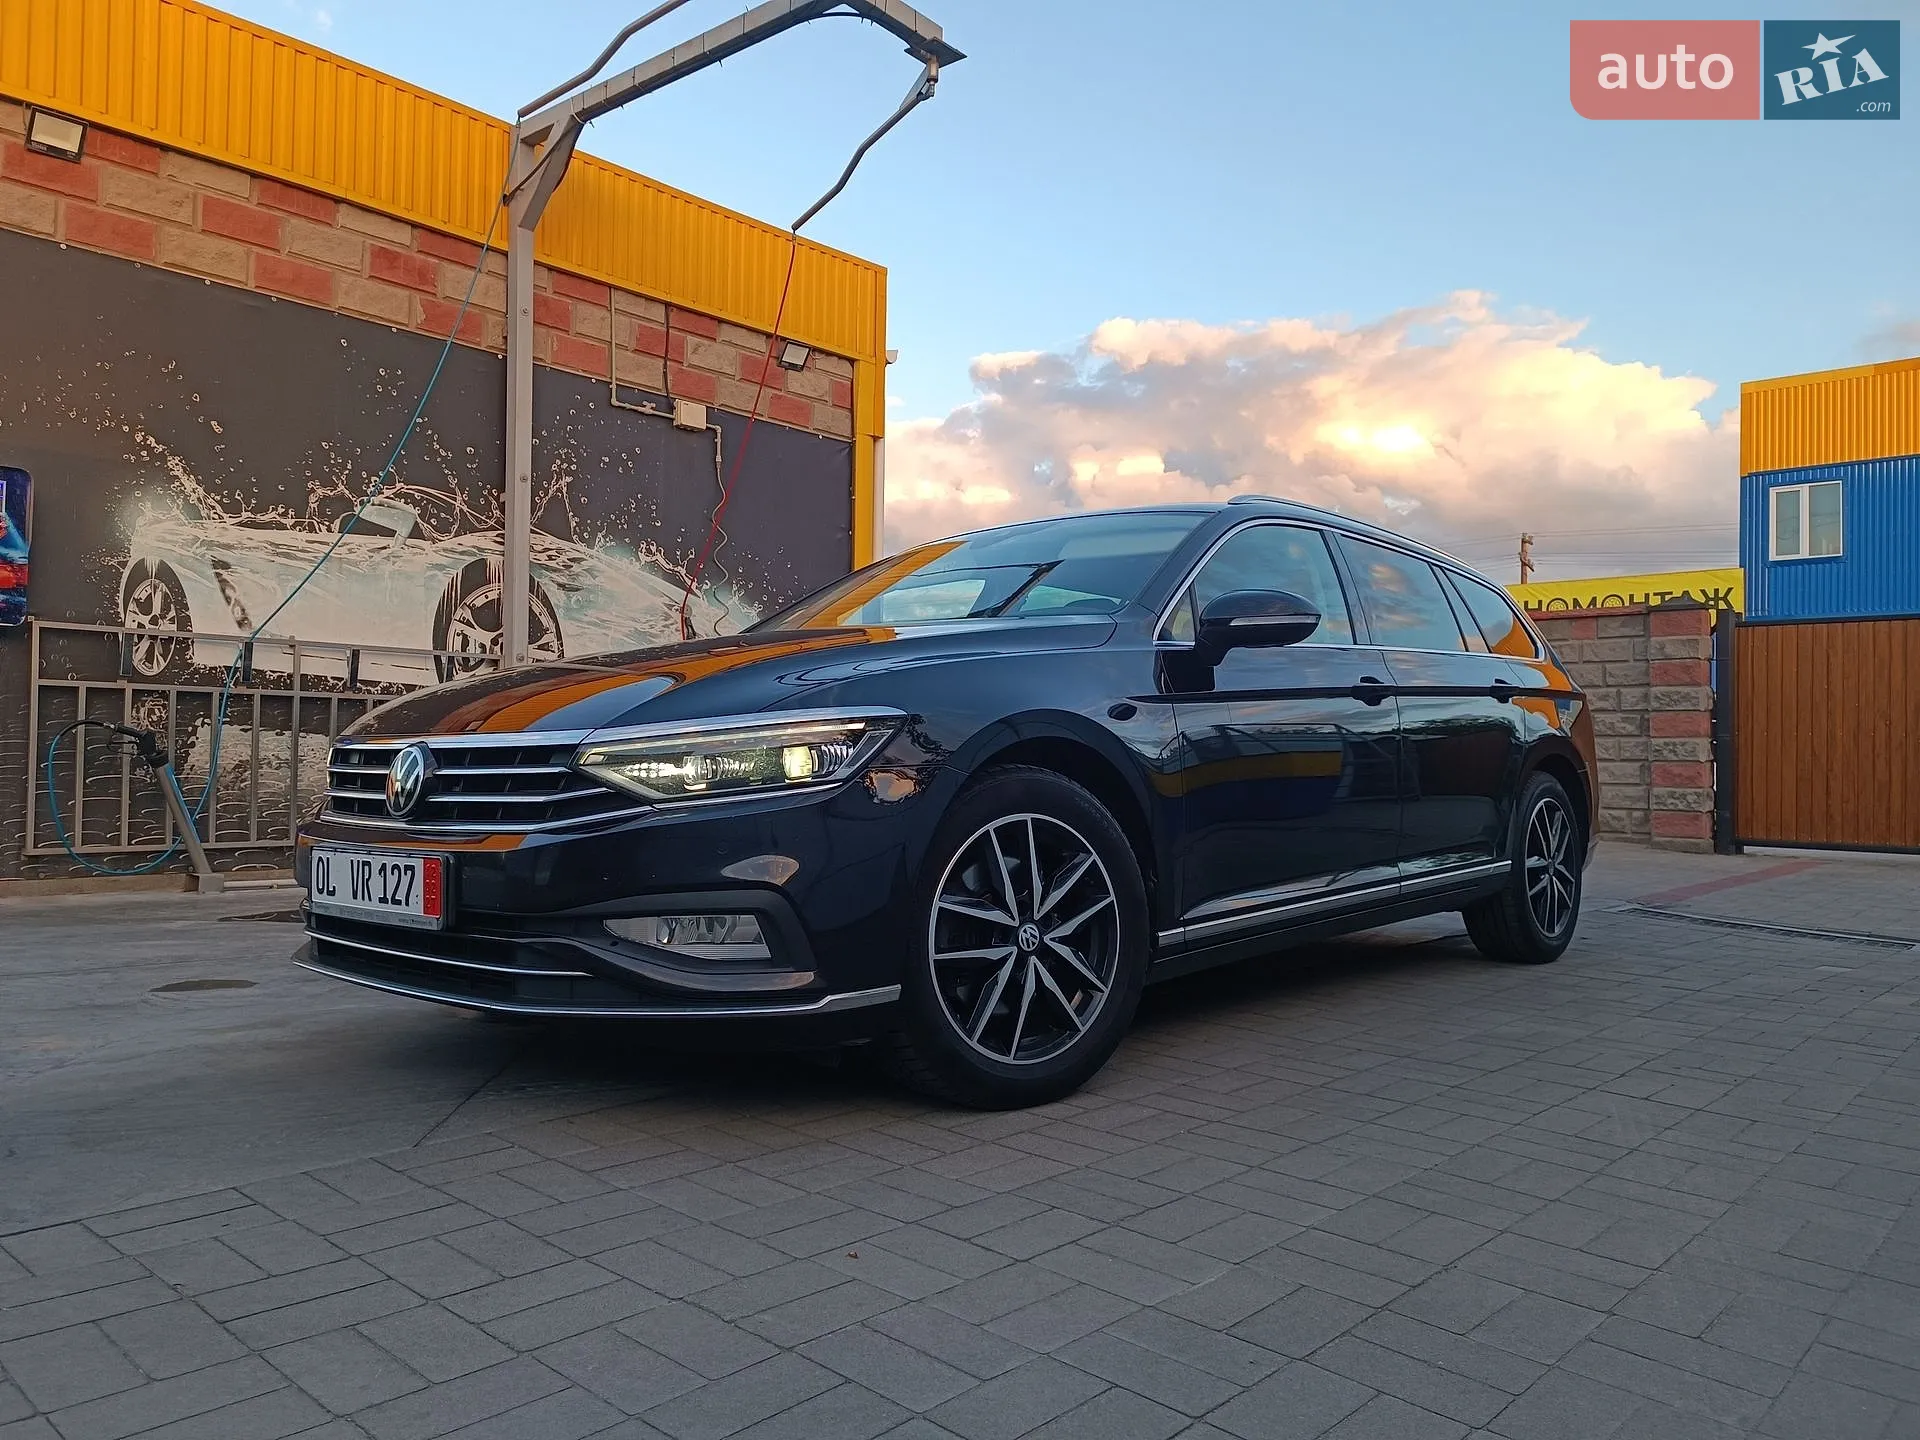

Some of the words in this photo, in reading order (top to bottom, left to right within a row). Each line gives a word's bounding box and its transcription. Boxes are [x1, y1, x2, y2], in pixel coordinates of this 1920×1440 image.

[316, 855, 336, 897] OL
[350, 859, 372, 902] VR
[378, 861, 416, 907] 127
